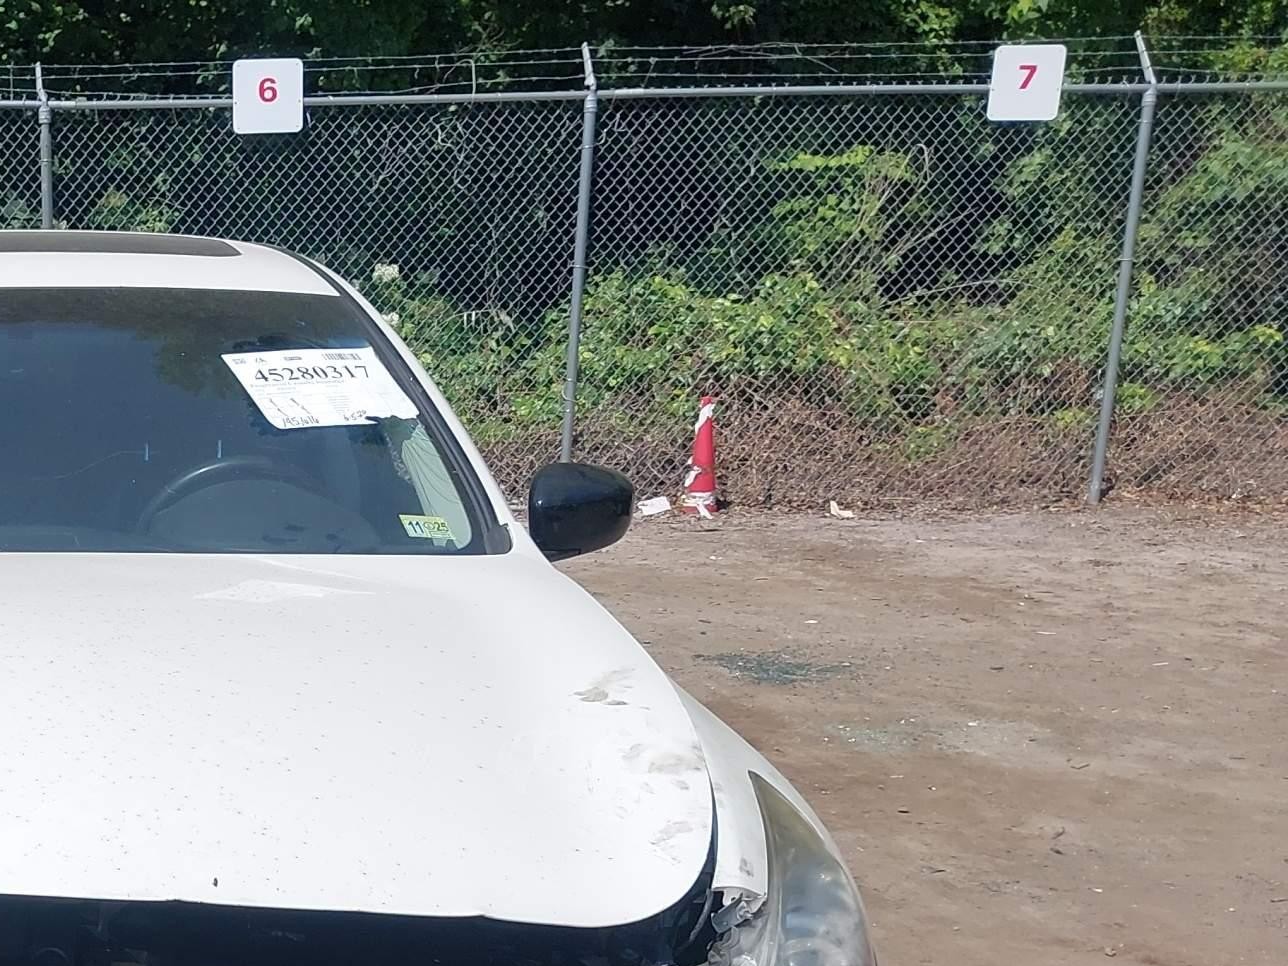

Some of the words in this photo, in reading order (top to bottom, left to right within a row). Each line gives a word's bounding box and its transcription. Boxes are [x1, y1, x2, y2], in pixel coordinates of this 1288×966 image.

[1018, 65, 1038, 89] 7
[258, 78, 277, 103] 6
[254, 365, 369, 382] 45280317
[408, 521, 425, 534] 11
